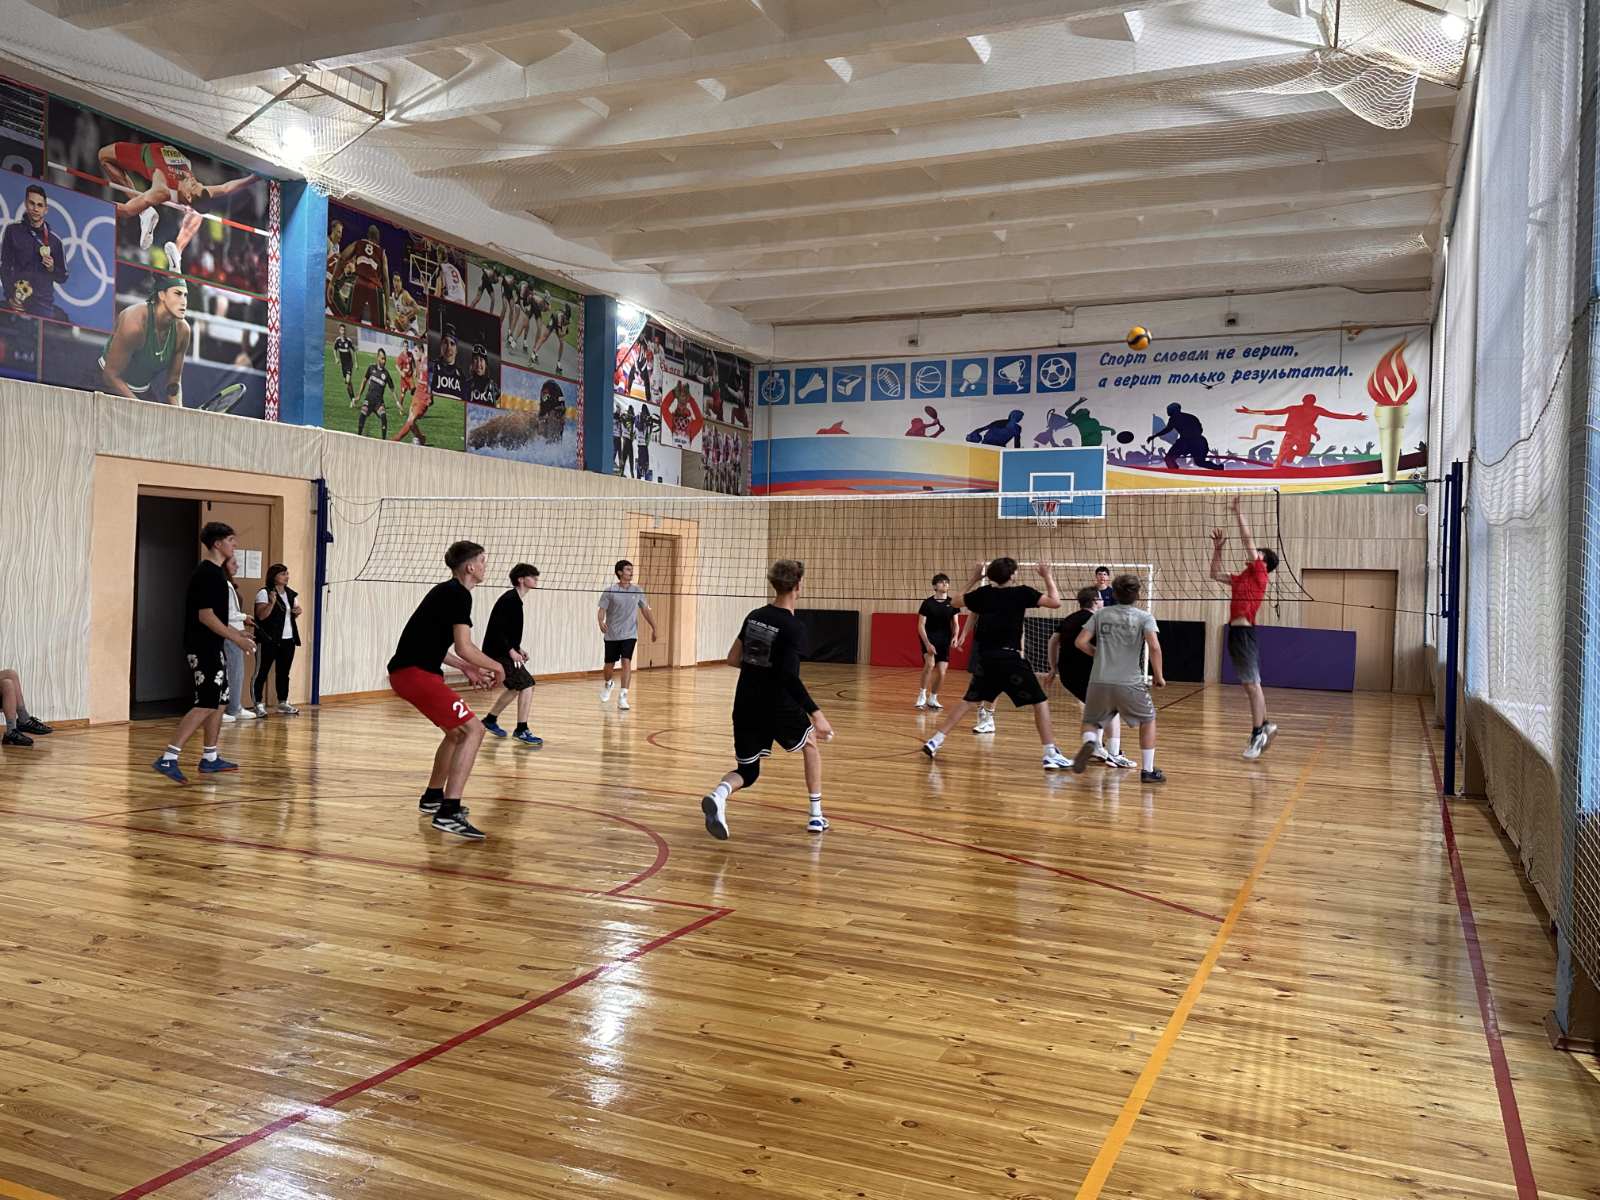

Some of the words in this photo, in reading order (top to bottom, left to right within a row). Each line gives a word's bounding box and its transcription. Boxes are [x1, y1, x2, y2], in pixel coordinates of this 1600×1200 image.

[364, 243, 374, 256] 8
[1099, 352, 1148, 368] Спорт
[1153, 349, 1209, 363] словам
[1215, 347, 1237, 360] не
[436, 375, 462, 392] JOKA
[1097, 377, 1109, 388] а
[1113, 373, 1162, 389] верит
[1167, 370, 1226, 384] только
[1230, 364, 1354, 384] результатам.
[469, 388, 495, 404] JOKA
[452, 698, 469, 719] 2
